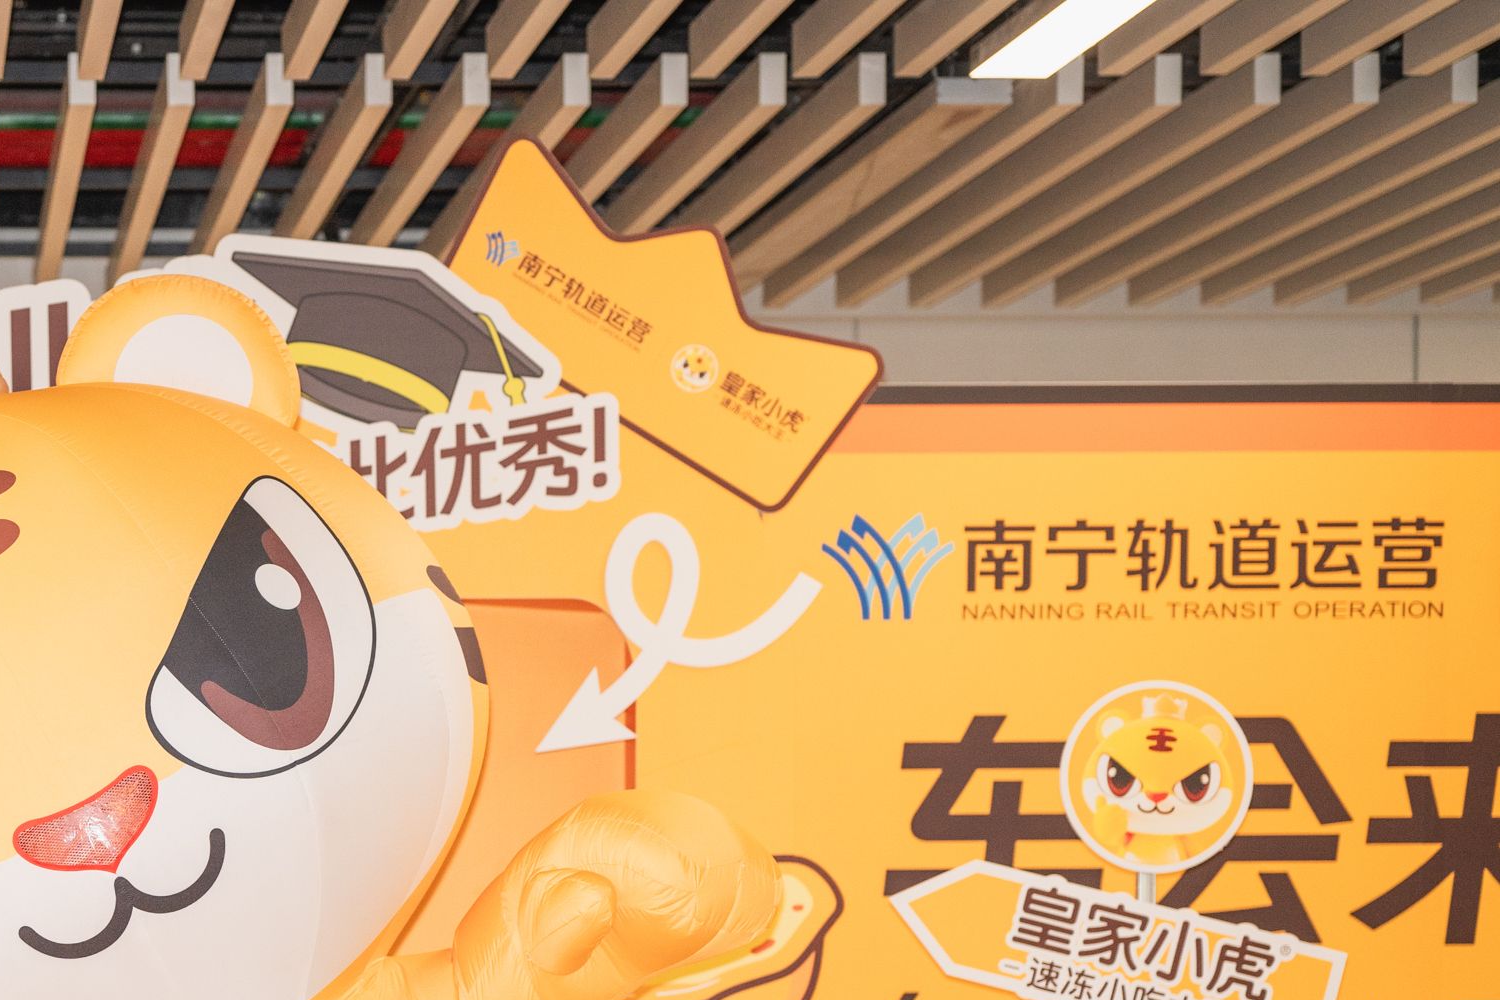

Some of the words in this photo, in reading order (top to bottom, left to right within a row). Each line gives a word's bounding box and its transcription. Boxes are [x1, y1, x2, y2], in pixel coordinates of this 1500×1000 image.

[517, 251, 652, 344] 南宁轨道运营
[719, 371, 804, 434] 皇家小虎
[963, 517, 1445, 592] 南宁轨道运营
[961, 602, 1085, 621] NANNING
[1095, 602, 1153, 621] RAIL
[1167, 602, 1280, 621] TRANSIT
[1293, 601, 1445, 620] OPERATION
